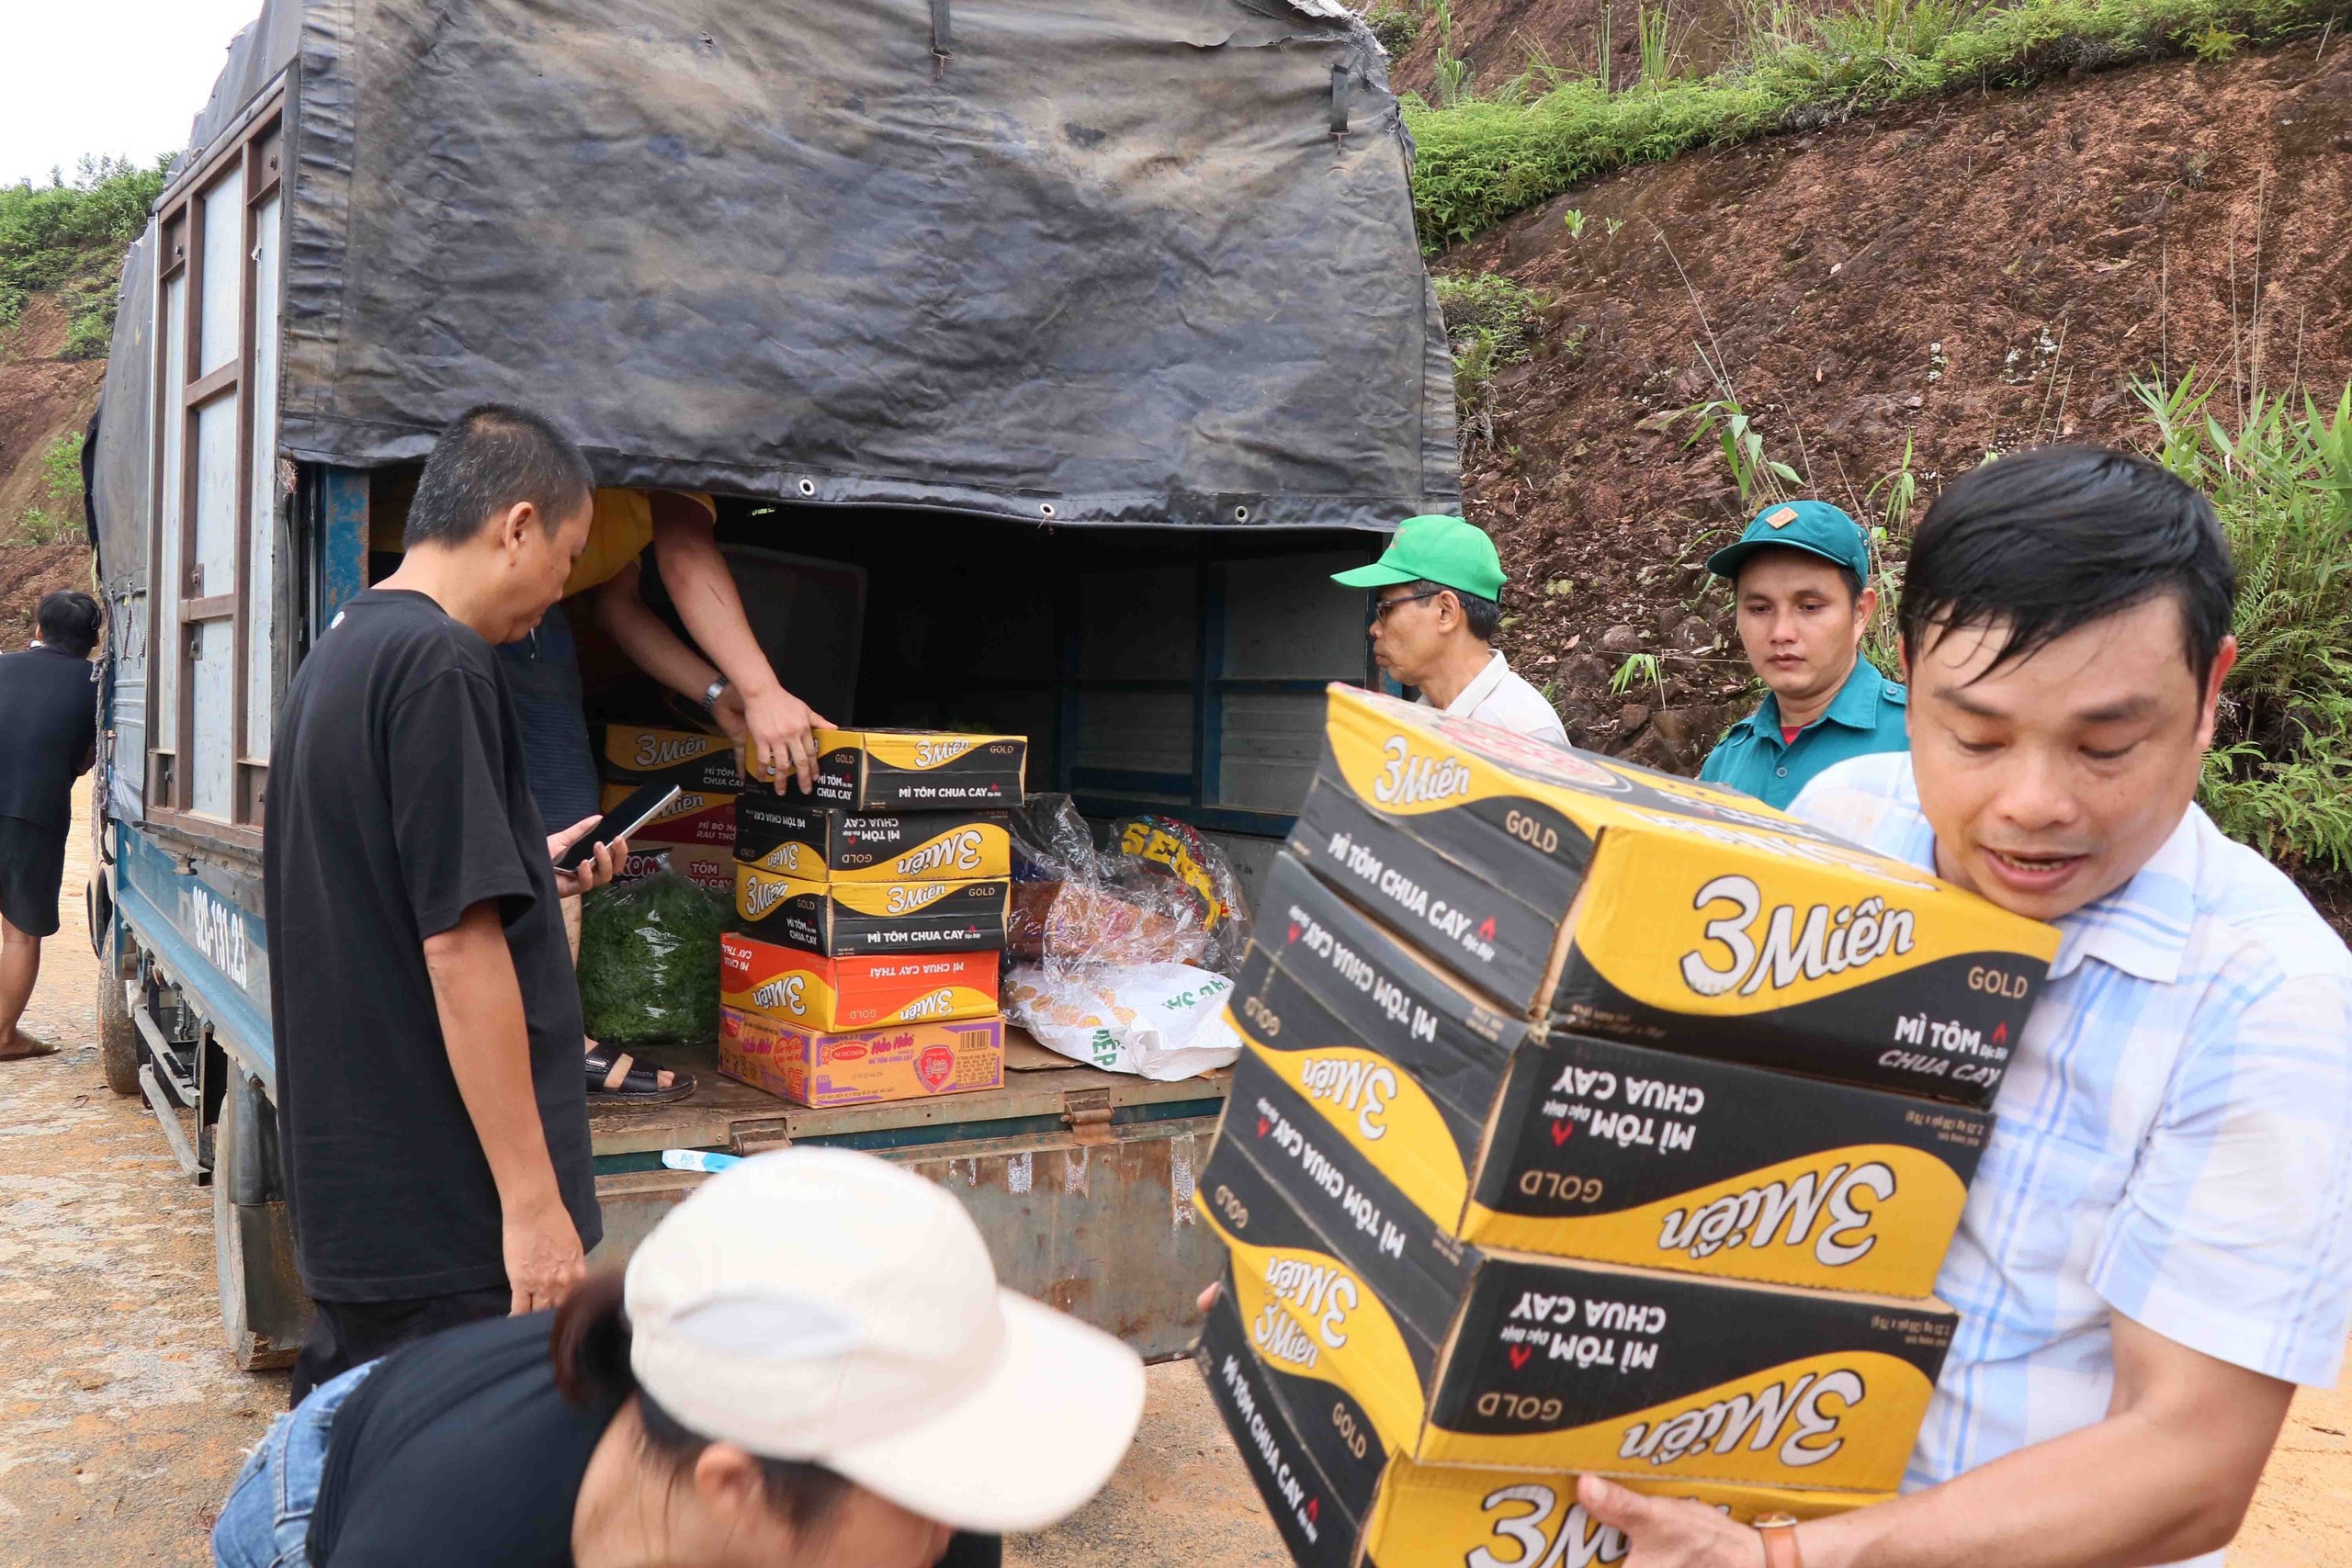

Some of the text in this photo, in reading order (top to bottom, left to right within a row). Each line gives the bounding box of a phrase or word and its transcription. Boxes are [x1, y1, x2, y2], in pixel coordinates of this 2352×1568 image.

[989, 745, 1014, 755] GOLD
[703, 777, 727, 786] CHUA
[899, 785, 911, 798] MÌ
[913, 785, 936, 798] TÔM
[938, 788, 967, 797] CHUA
[967, 787, 988, 797] CAY
[843, 818, 899, 829] CHUA CAY
[861, 829, 887, 843] TÔM
[1505, 809, 1559, 854] GOLD
[842, 853, 873, 863] GOLD
[968, 887, 995, 897] GOLD
[1327, 832, 1352, 862] MÌ
[1346, 844, 1384, 885] TÔM
[1380, 869, 1429, 918] CHUA
[1428, 900, 1473, 941] CAY
[867, 930, 881, 943] MÌ
[883, 931, 909, 942] TÔM
[910, 931, 941, 942] CHUA
[943, 930, 965, 940] CAY
[1302, 921, 1334, 958] CAY
[899, 964, 920, 976] CAY
[923, 963, 950, 974] CHUA
[952, 962, 964, 974] MÌ
[1333, 942, 1375, 992] CHUA
[1967, 966, 2029, 999] GOLD
[850, 1009, 876, 1020] GOLD
[1244, 995, 1281, 1037] GOLD
[1372, 976, 1411, 1025] TÔM
[1411, 1005, 1438, 1043] MÌ
[1894, 1011, 1928, 1045] MÌ
[1930, 1020, 1982, 1055] TÔM
[1878, 1049, 2002, 1089] CHUA CAY
[1550, 1065, 1705, 1115] CHUA CAY
[1272, 1117, 1305, 1157] CAY
[1589, 1109, 1655, 1148] TÔM
[1658, 1121, 1697, 1156] MÌ
[1302, 1142, 1345, 1199] CHUA
[1519, 1169, 1603, 1203] GOLD
[1214, 1184, 1250, 1229] GOLD
[1341, 1184, 1381, 1237] TÔM
[1379, 1220, 1407, 1259] MÌ
[1509, 1292, 1668, 1335] CHUA CAY
[1548, 1332, 1616, 1370] TÔM
[1620, 1340, 1659, 1375] MÌ
[1476, 1392, 1564, 1421] GOLD
[1332, 1402, 1367, 1460] GOLD
[1250, 1413, 1281, 1474] CHUA
[1276, 1462, 1306, 1511] CAY
